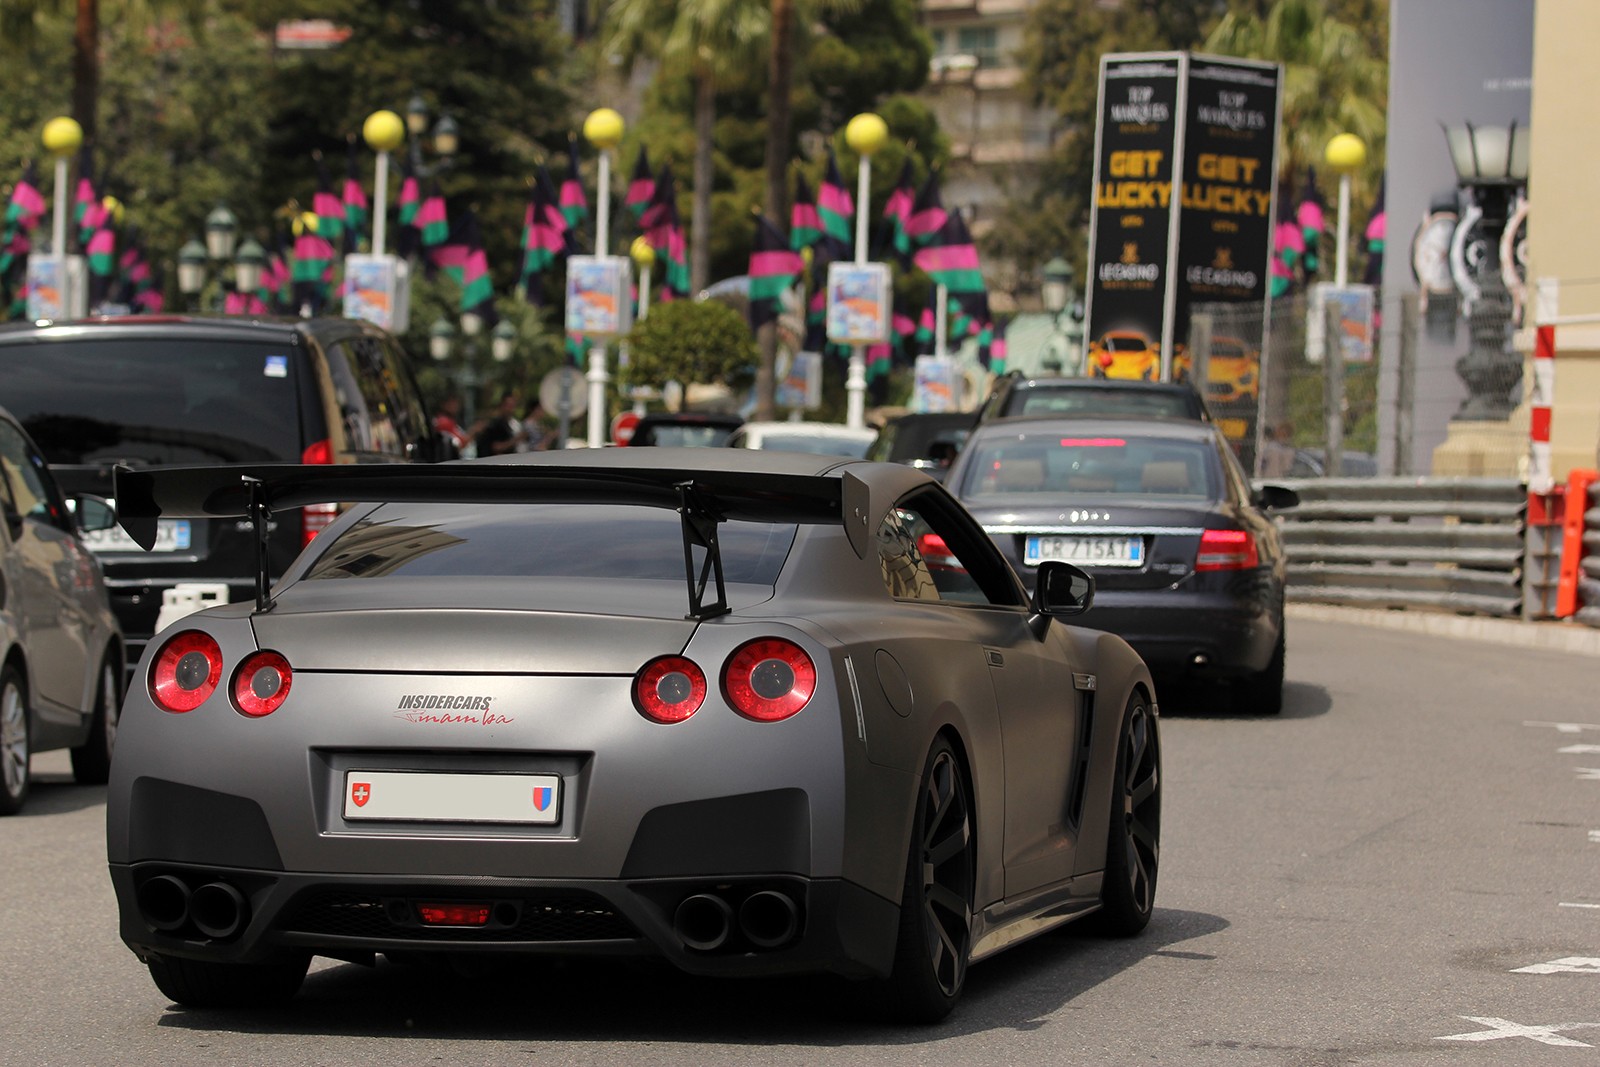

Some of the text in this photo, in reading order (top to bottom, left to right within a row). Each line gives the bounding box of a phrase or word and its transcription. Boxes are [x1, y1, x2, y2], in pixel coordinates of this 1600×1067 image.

[1128, 86, 1154, 104] TOP
[1109, 150, 1164, 178] GET
[1197, 152, 1261, 184] GET
[1096, 181, 1172, 208] LUCKY
[1182, 182, 1271, 217] LUCKY
[398, 695, 492, 710] INSIDERCARS
